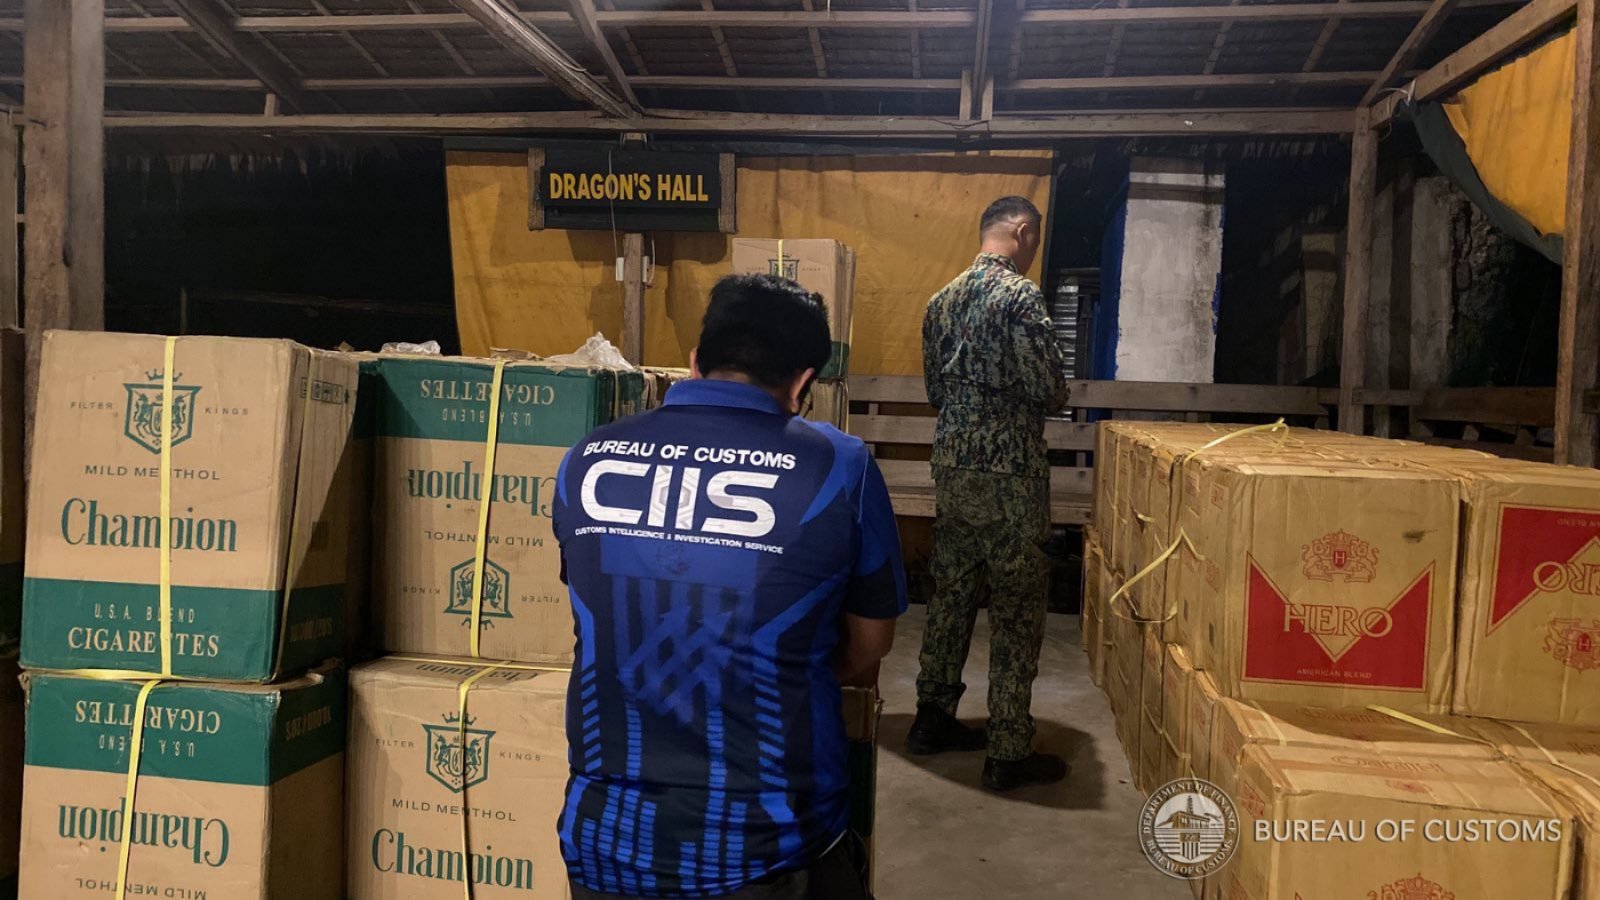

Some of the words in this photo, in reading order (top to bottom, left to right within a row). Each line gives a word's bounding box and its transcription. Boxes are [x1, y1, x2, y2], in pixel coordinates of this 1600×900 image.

[550, 173, 651, 200] DRAGON'S
[657, 174, 709, 202] HALL
[421, 379, 555, 405] CIGAETTES
[70, 401, 112, 410] FILTER
[205, 407, 248, 415] KINGS
[442, 408, 484, 423] BLEND
[583, 440, 656, 457] BUREAU
[660, 444, 689, 460] OF
[694, 447, 796, 470] CUSTOMS
[85, 464, 128, 476] MILD
[134, 467, 220, 481] METHOL
[581, 459, 780, 538] CIIS
[424, 530, 499, 544] MNTHOL
[505, 536, 544, 547] MILD
[575, 526, 607, 536] CUSTOMS
[608, 527, 665, 540] INTELLIGENCE
[674, 534, 742, 548] INVESTIGATION
[745, 541, 784, 554] SERVICE
[402, 585, 440, 594] KINGS
[521, 596, 560, 604] FILTER
[1283, 603, 1393, 638] HERO
[68, 627, 220, 657] CIGARETES
[1297, 668, 1341, 677] AMERICAN
[1344, 670, 1372, 679] BLEND
[376, 738, 415, 748] FILTER
[499, 751, 542, 762] KINGS
[392, 798, 431, 812] MILD
[436, 803, 517, 822] MENTHOL
[165, 887, 207, 900] MILD
